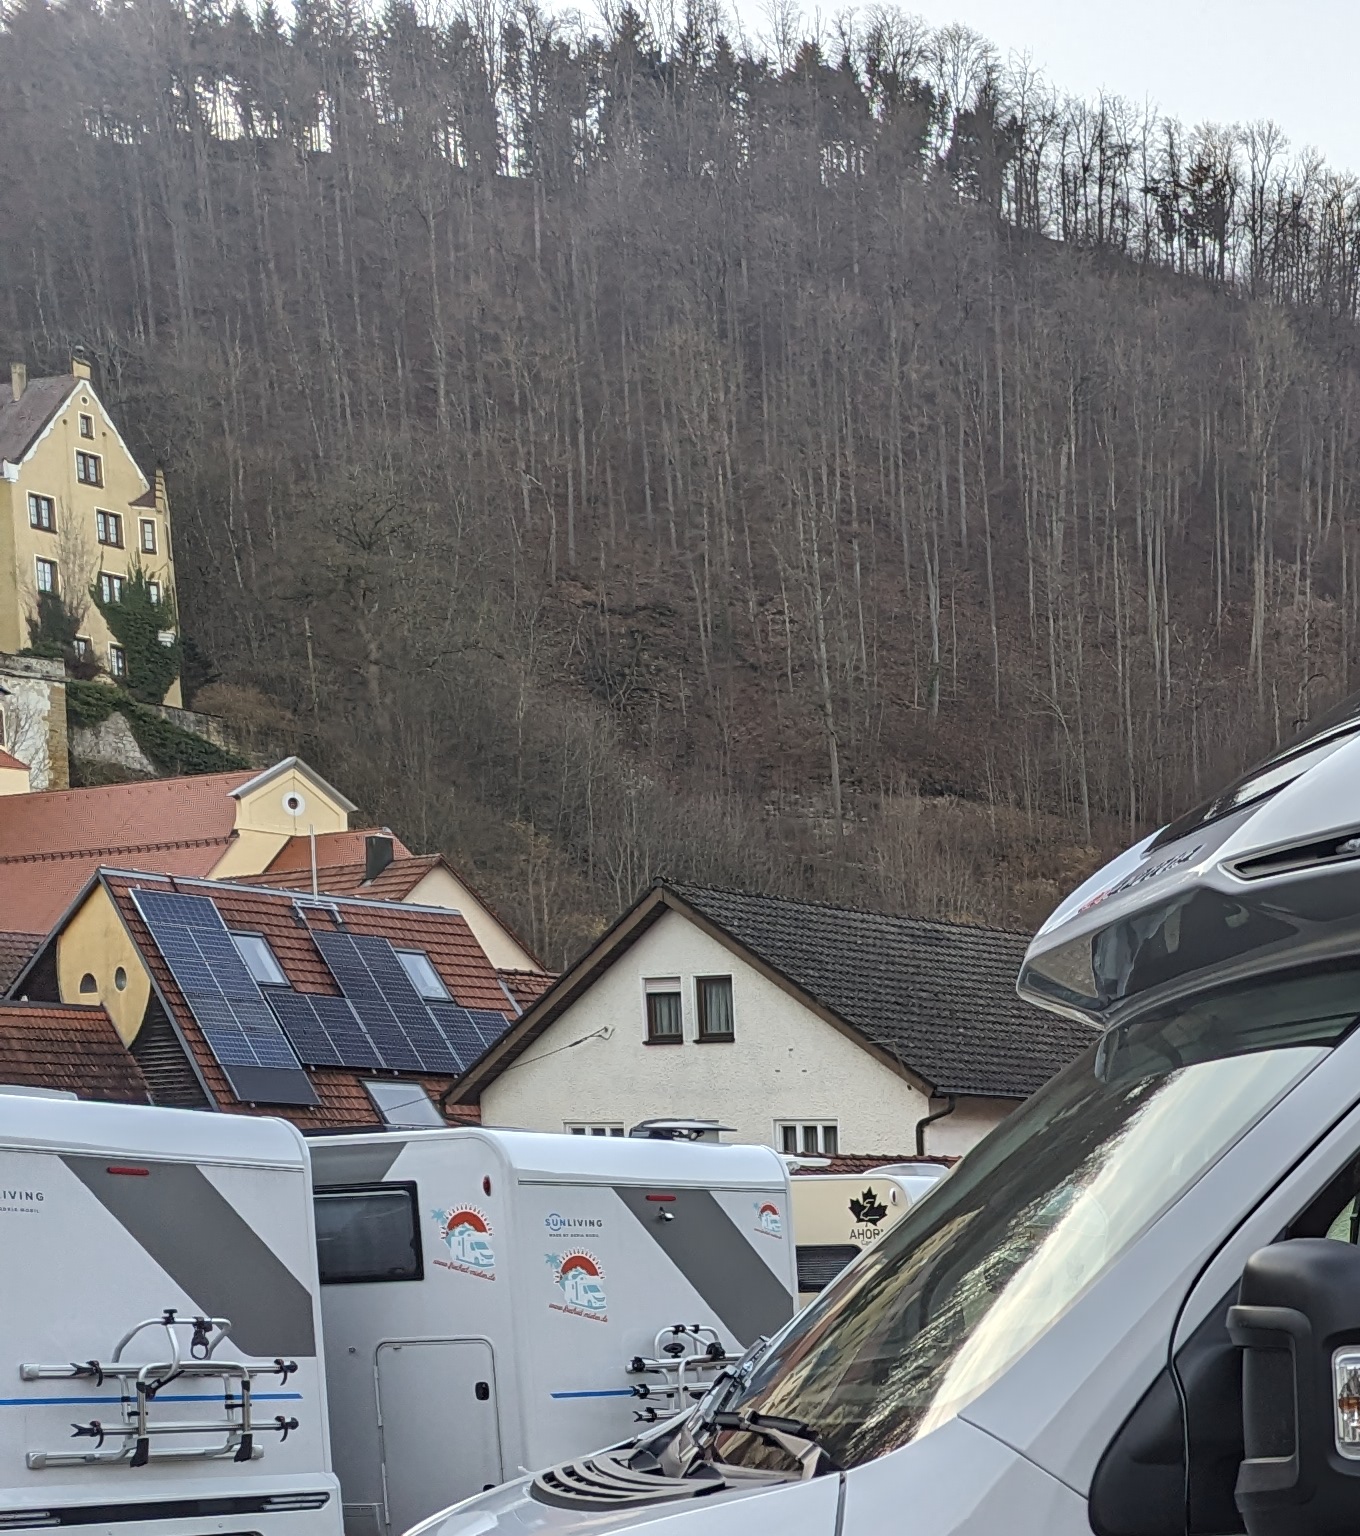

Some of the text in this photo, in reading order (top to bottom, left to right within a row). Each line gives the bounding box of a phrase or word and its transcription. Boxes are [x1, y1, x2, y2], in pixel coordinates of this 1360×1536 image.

[0, 1190, 44, 1201] IVING
[545, 1217, 603, 1228] SUNLIVING
[849, 1228, 883, 1240] AHOR
